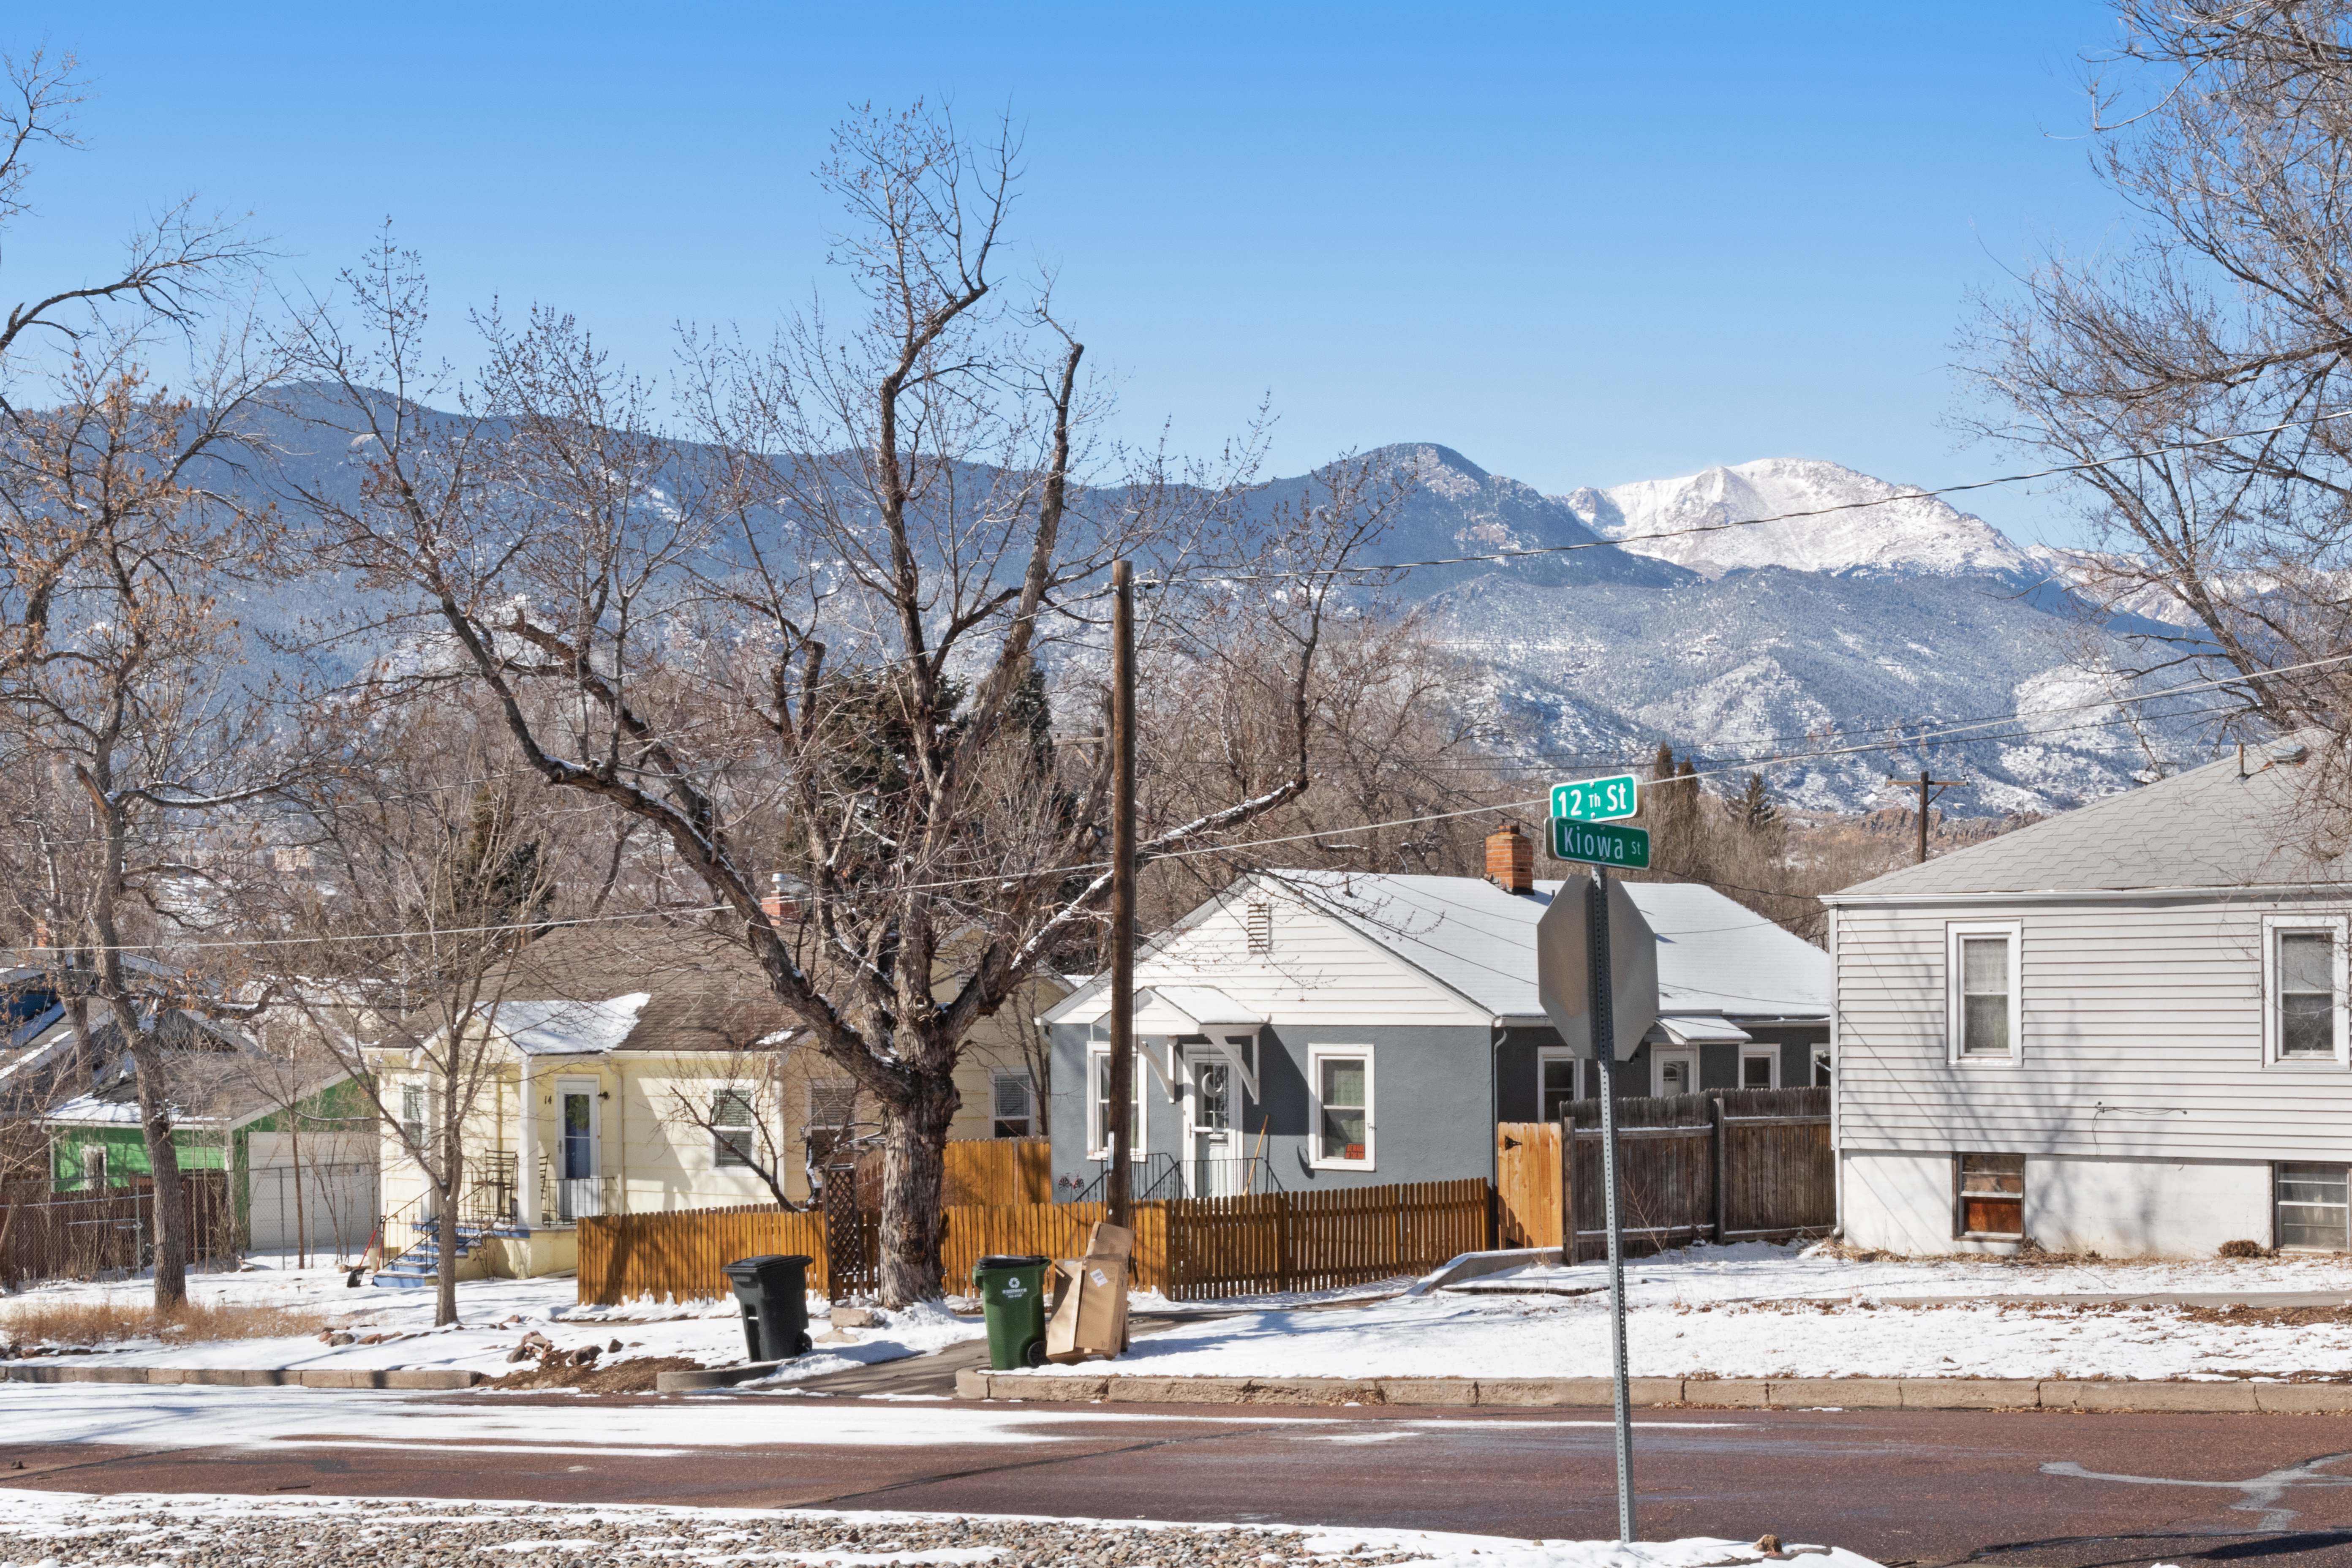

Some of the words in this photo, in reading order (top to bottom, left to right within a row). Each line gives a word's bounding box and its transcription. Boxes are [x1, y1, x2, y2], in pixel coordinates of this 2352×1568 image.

[1607, 783, 1626, 811] St
[1564, 826, 1624, 860] Kiowa
[1631, 841, 1642, 855] St
[544, 1095, 552, 1105] 14
